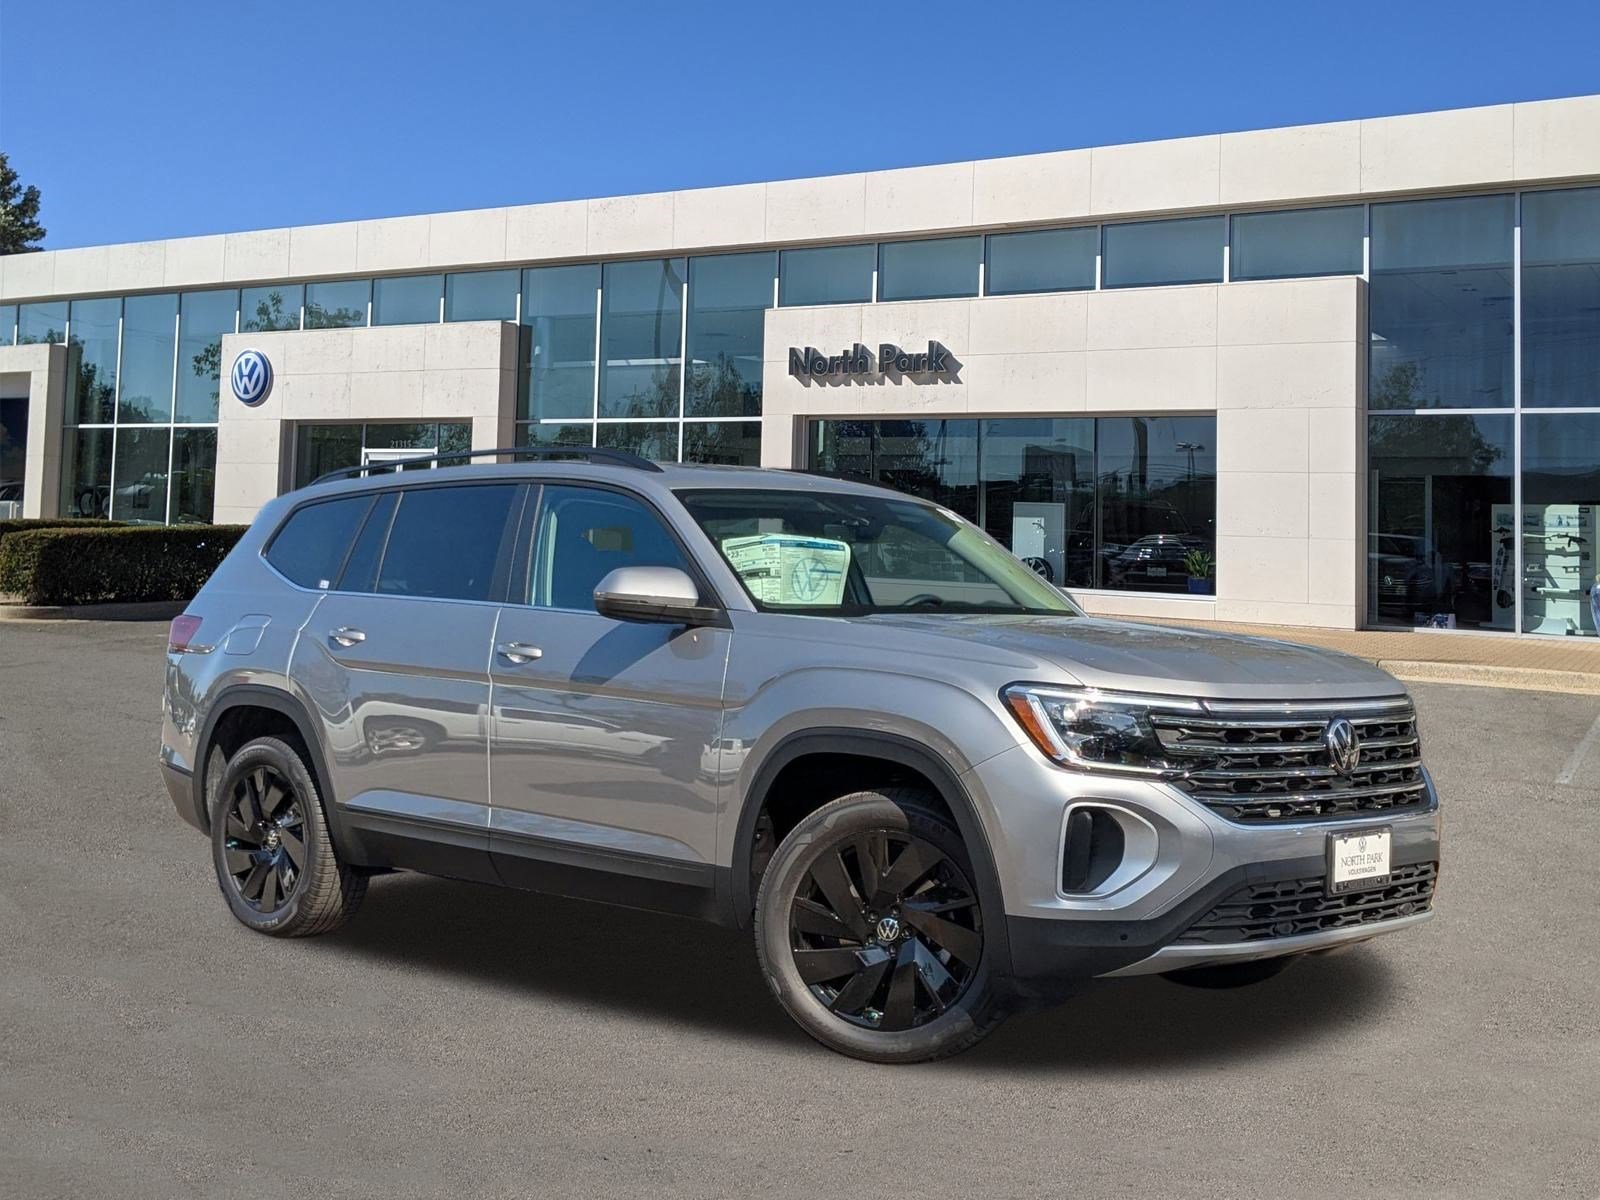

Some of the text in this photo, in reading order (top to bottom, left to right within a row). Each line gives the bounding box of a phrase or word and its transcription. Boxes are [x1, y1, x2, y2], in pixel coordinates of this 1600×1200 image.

[788, 340, 946, 377] North Park
[1341, 852, 1383, 868] NORTH PARK
